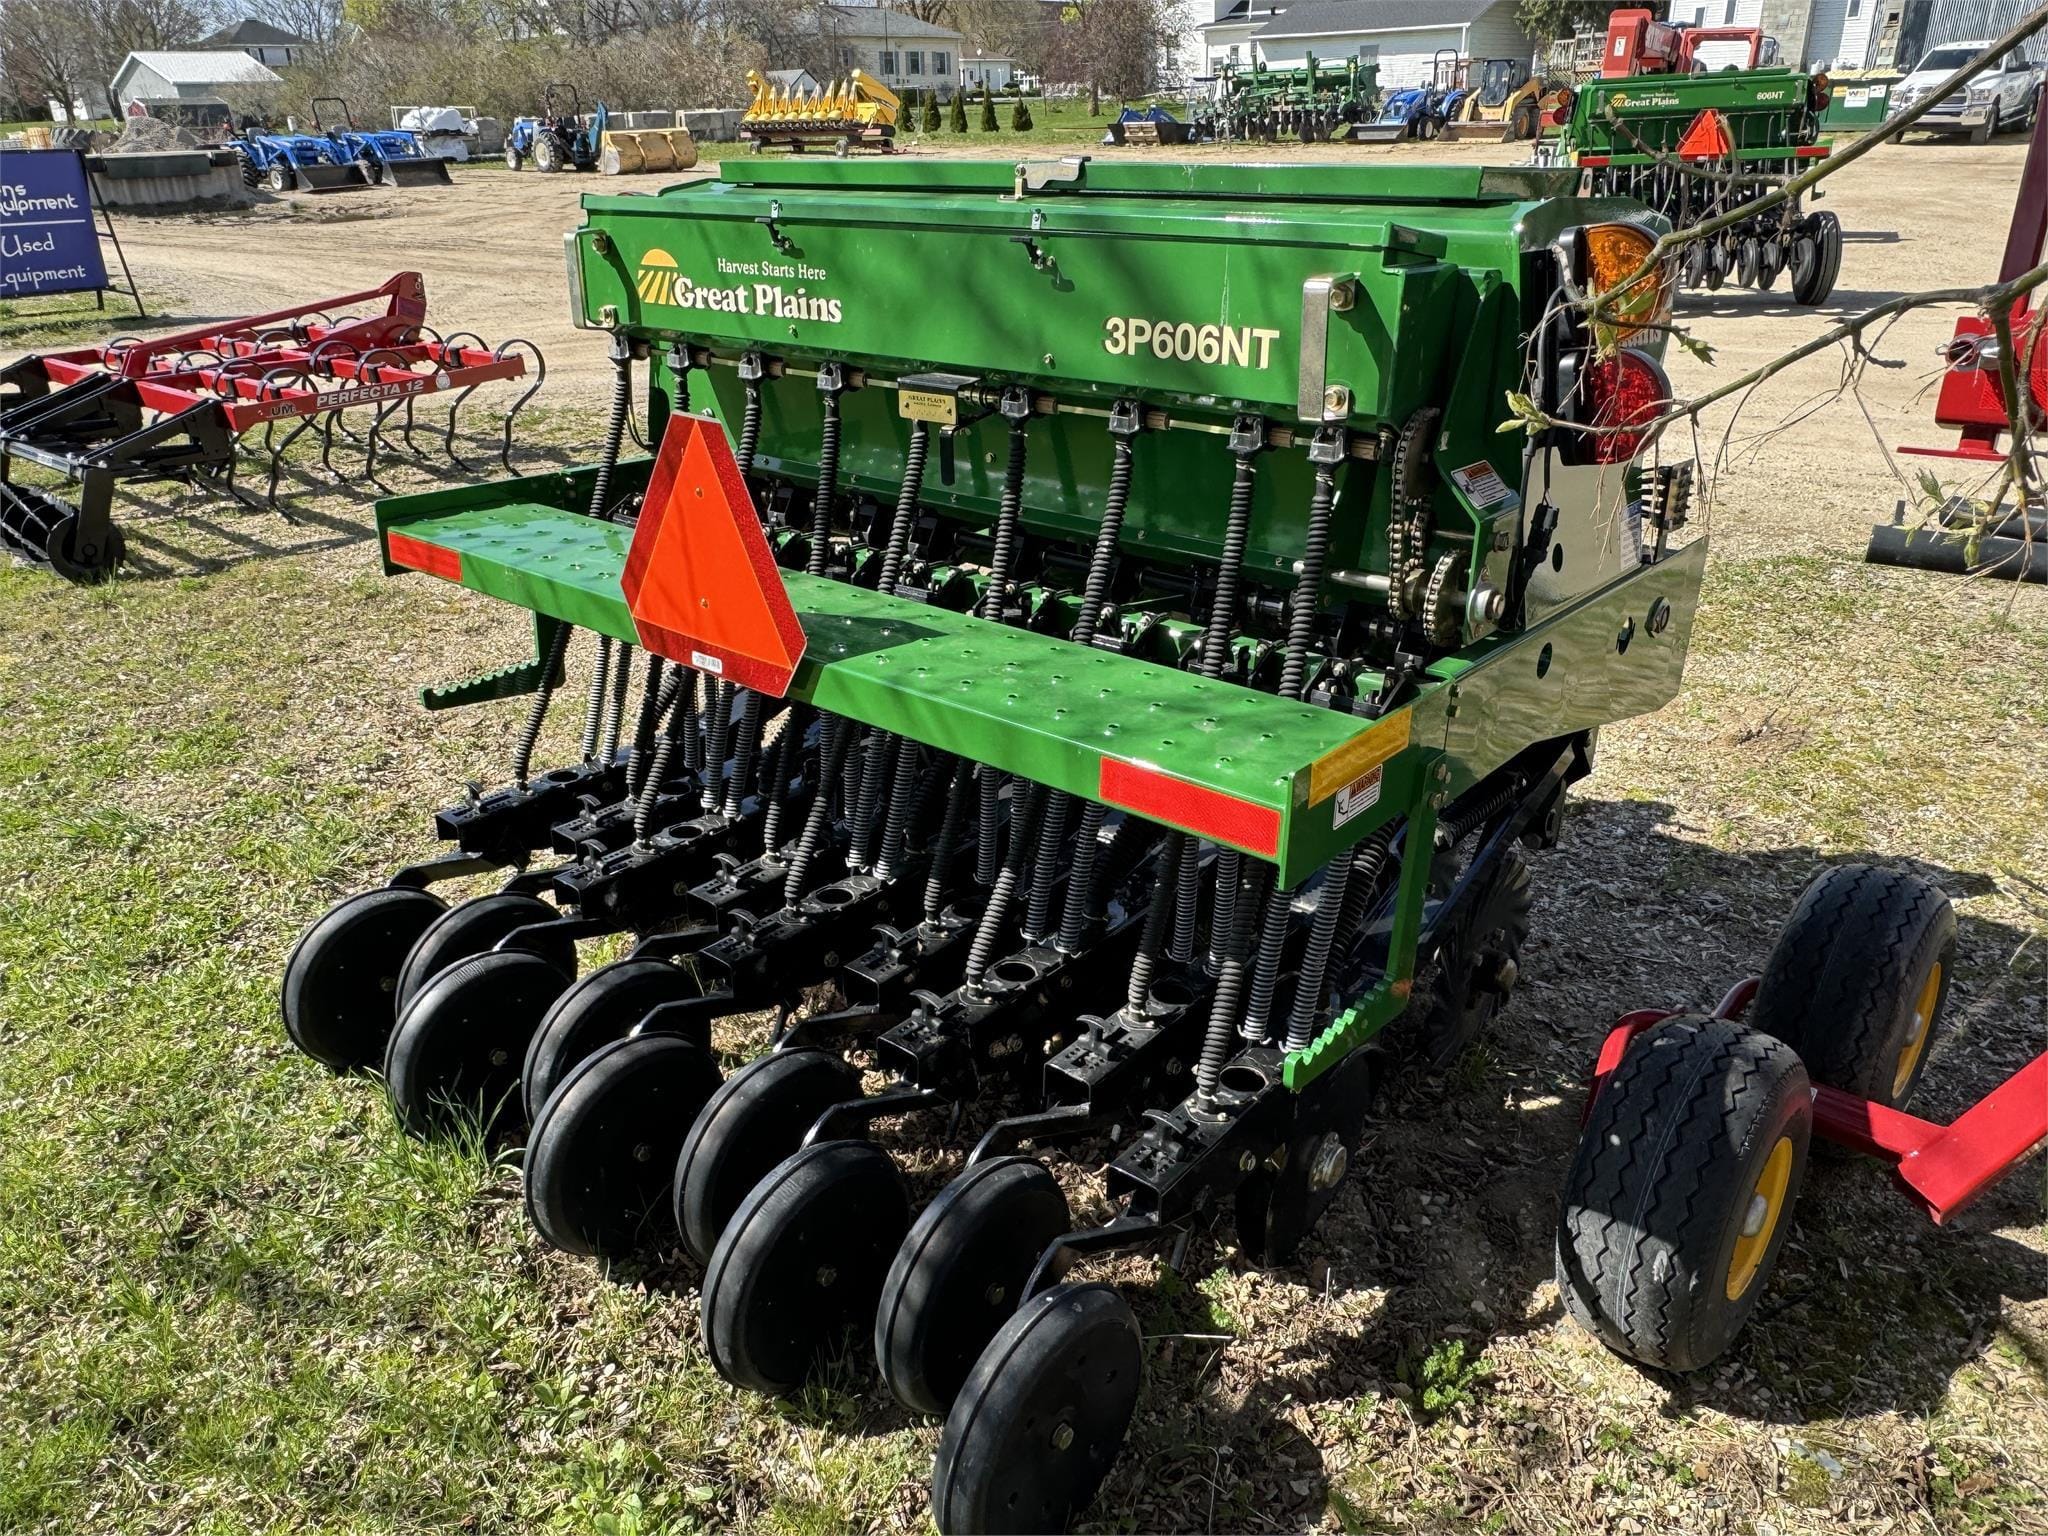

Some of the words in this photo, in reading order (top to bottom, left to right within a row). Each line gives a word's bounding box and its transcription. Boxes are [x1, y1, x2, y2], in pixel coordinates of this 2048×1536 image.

[1624, 98, 1651, 107] Great
[1651, 97, 1680, 106] Plains
[1, 232, 55, 257] Used
[0, 265, 87, 291] quipment
[717, 257, 760, 276] Harvest
[761, 260, 795, 278] Starts
[798, 263, 827, 280] Here
[673, 276, 750, 314] Great
[752, 283, 843, 323] Plains
[1103, 315, 1280, 370] 3P606NT
[316, 383, 401, 407] PERFECTA
[406, 379, 424, 392] 12
